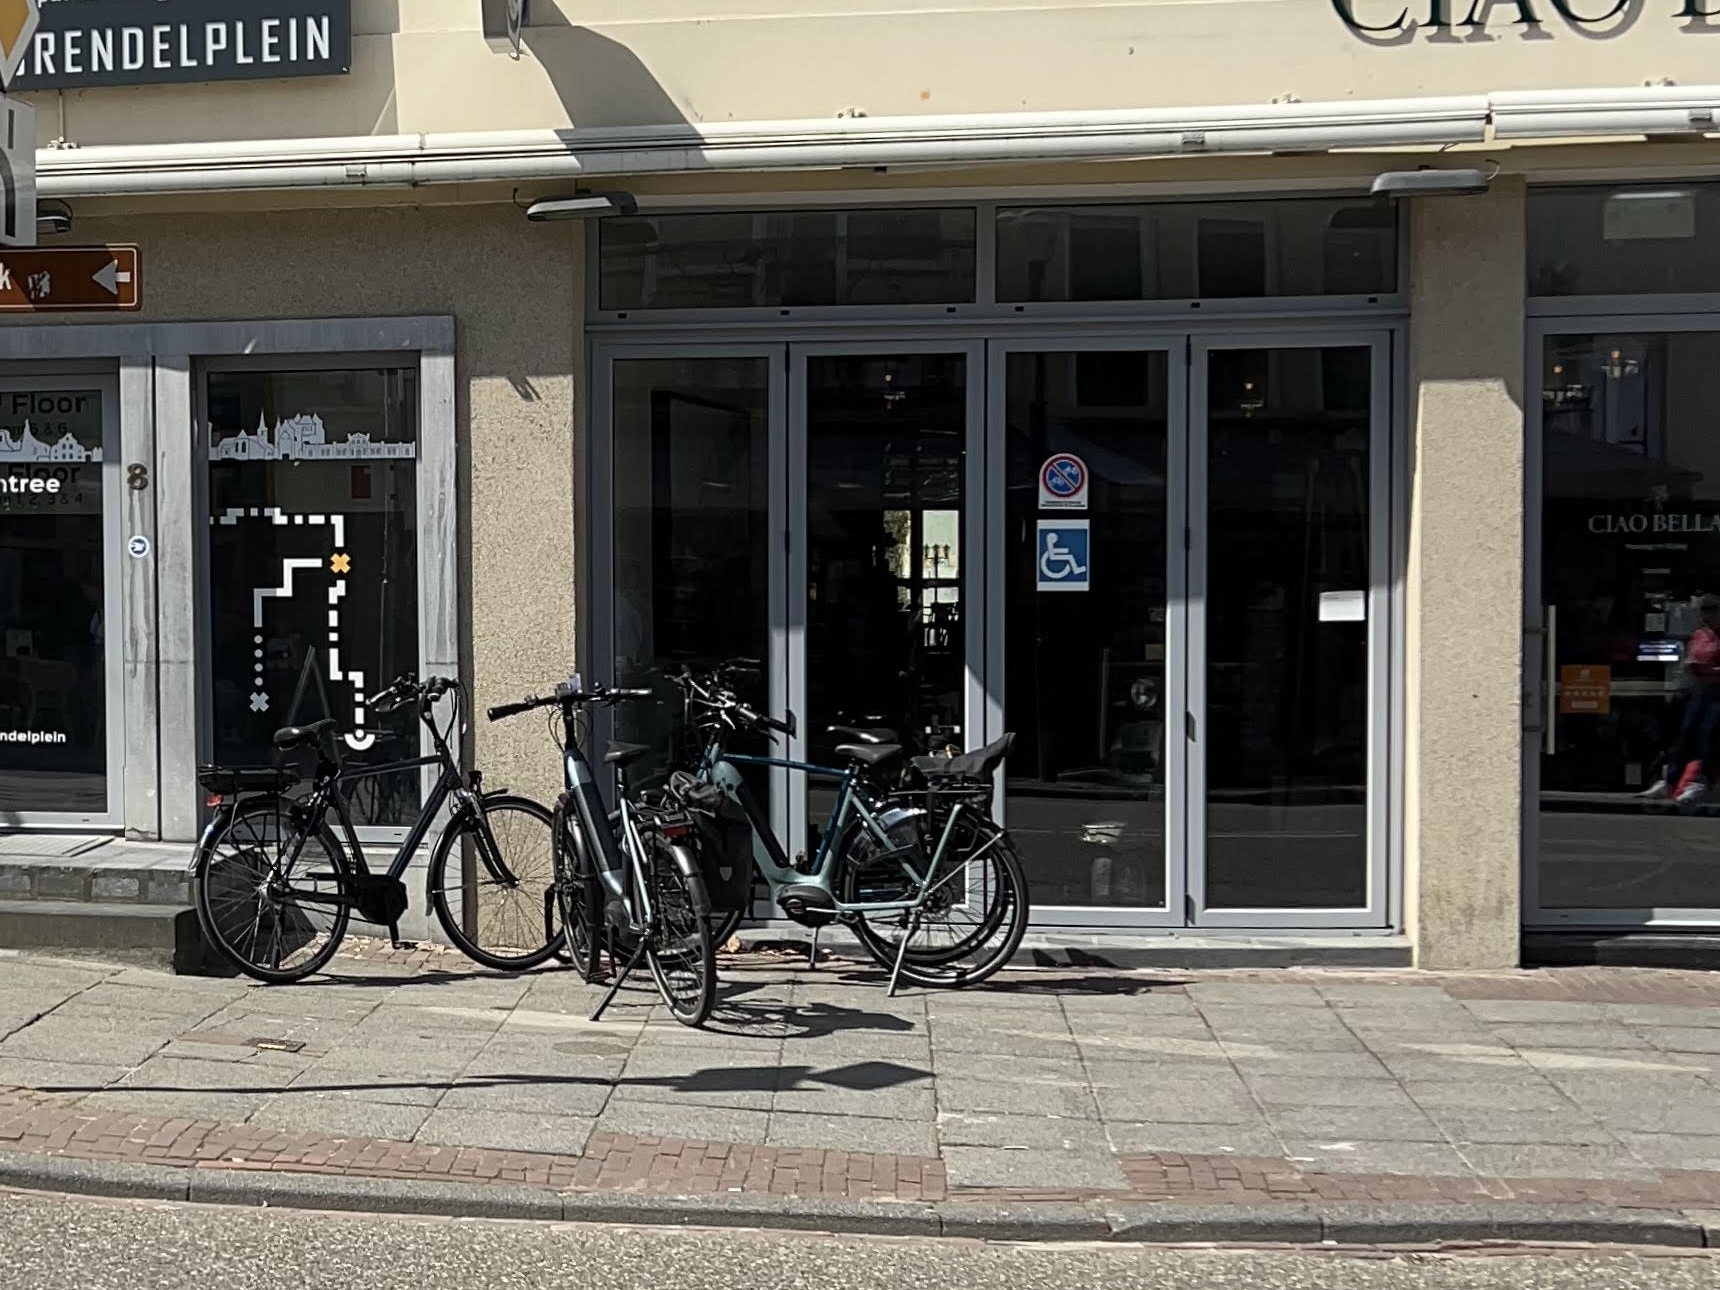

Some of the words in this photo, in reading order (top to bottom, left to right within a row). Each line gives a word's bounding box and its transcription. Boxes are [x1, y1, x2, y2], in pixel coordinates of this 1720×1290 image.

[12, 394, 87, 414] Floor
[126, 463, 149, 490] 8
[1589, 514, 1648, 533] CIAO
